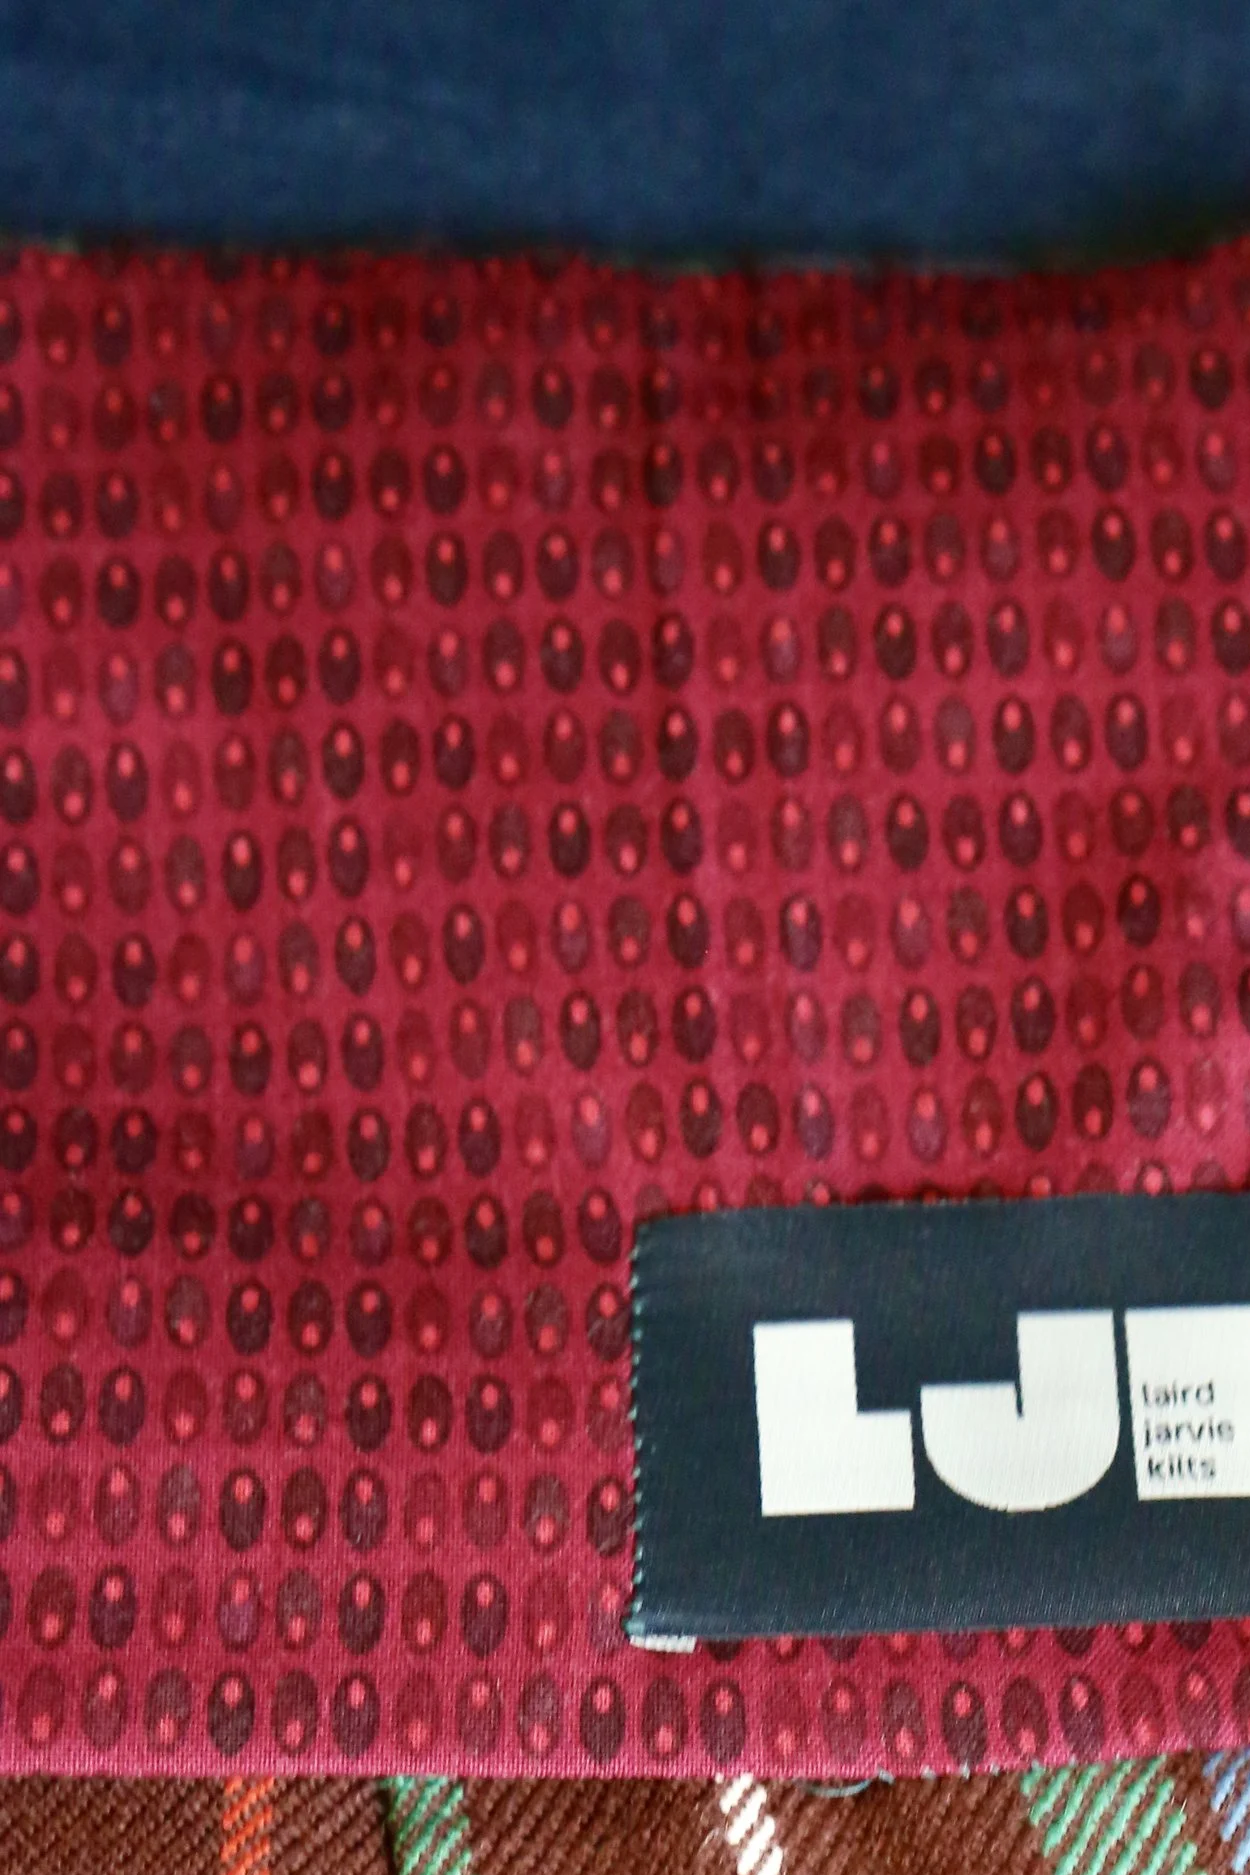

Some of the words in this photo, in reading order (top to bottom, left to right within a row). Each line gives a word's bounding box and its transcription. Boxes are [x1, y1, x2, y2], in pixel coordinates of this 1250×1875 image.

[1142, 1380, 1214, 1406] laird
[1144, 1417, 1234, 1448] jarvie
[1147, 1456, 1215, 1479] kilts
